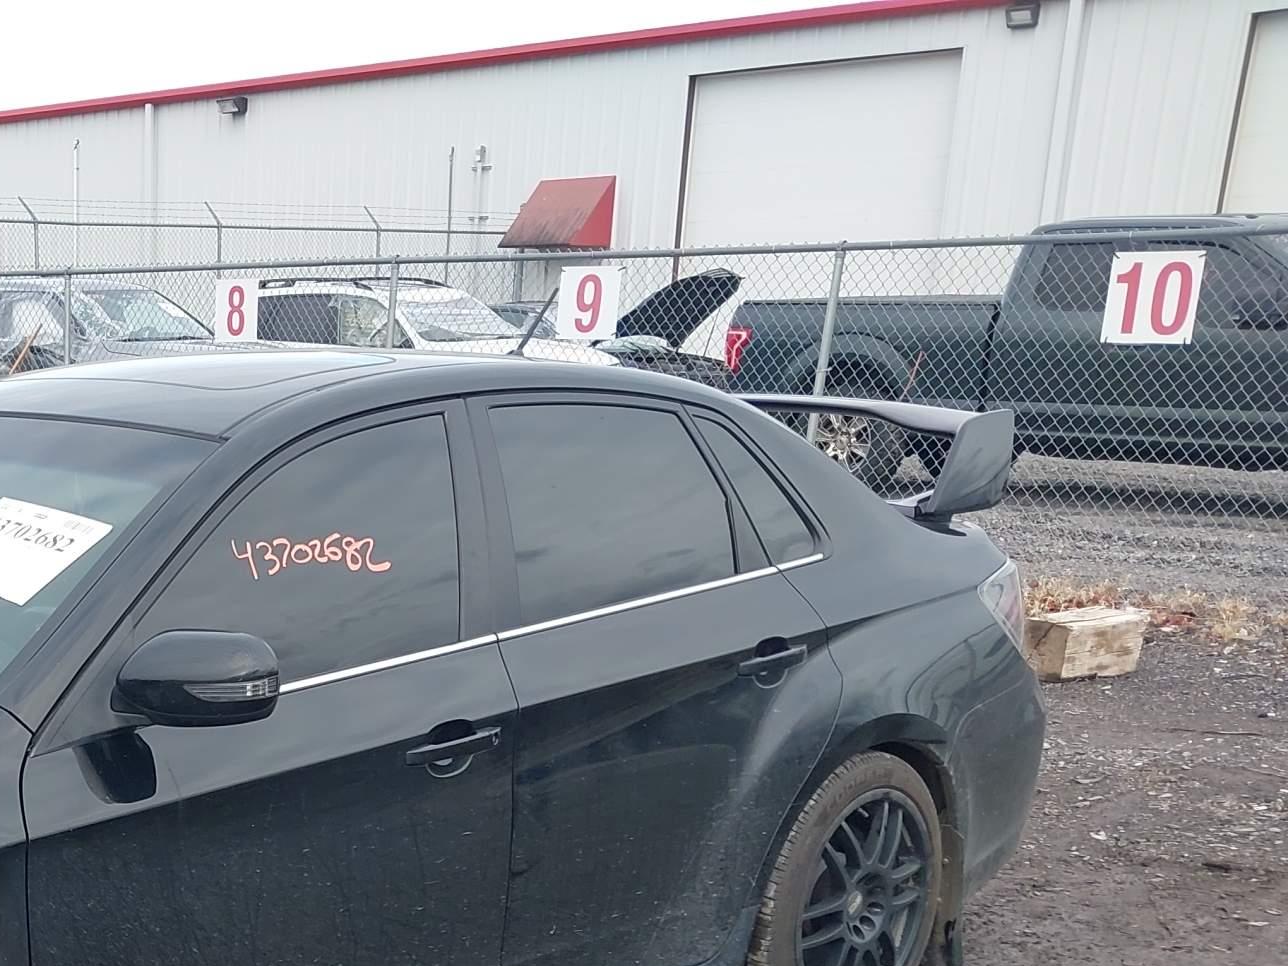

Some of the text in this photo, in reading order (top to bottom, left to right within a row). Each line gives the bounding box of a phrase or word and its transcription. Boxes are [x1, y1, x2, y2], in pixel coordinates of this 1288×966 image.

[227, 285, 245, 337] 8
[574, 274, 603, 333] 9
[1116, 261, 1193, 336] 10
[231, 532, 393, 580] 43702682
